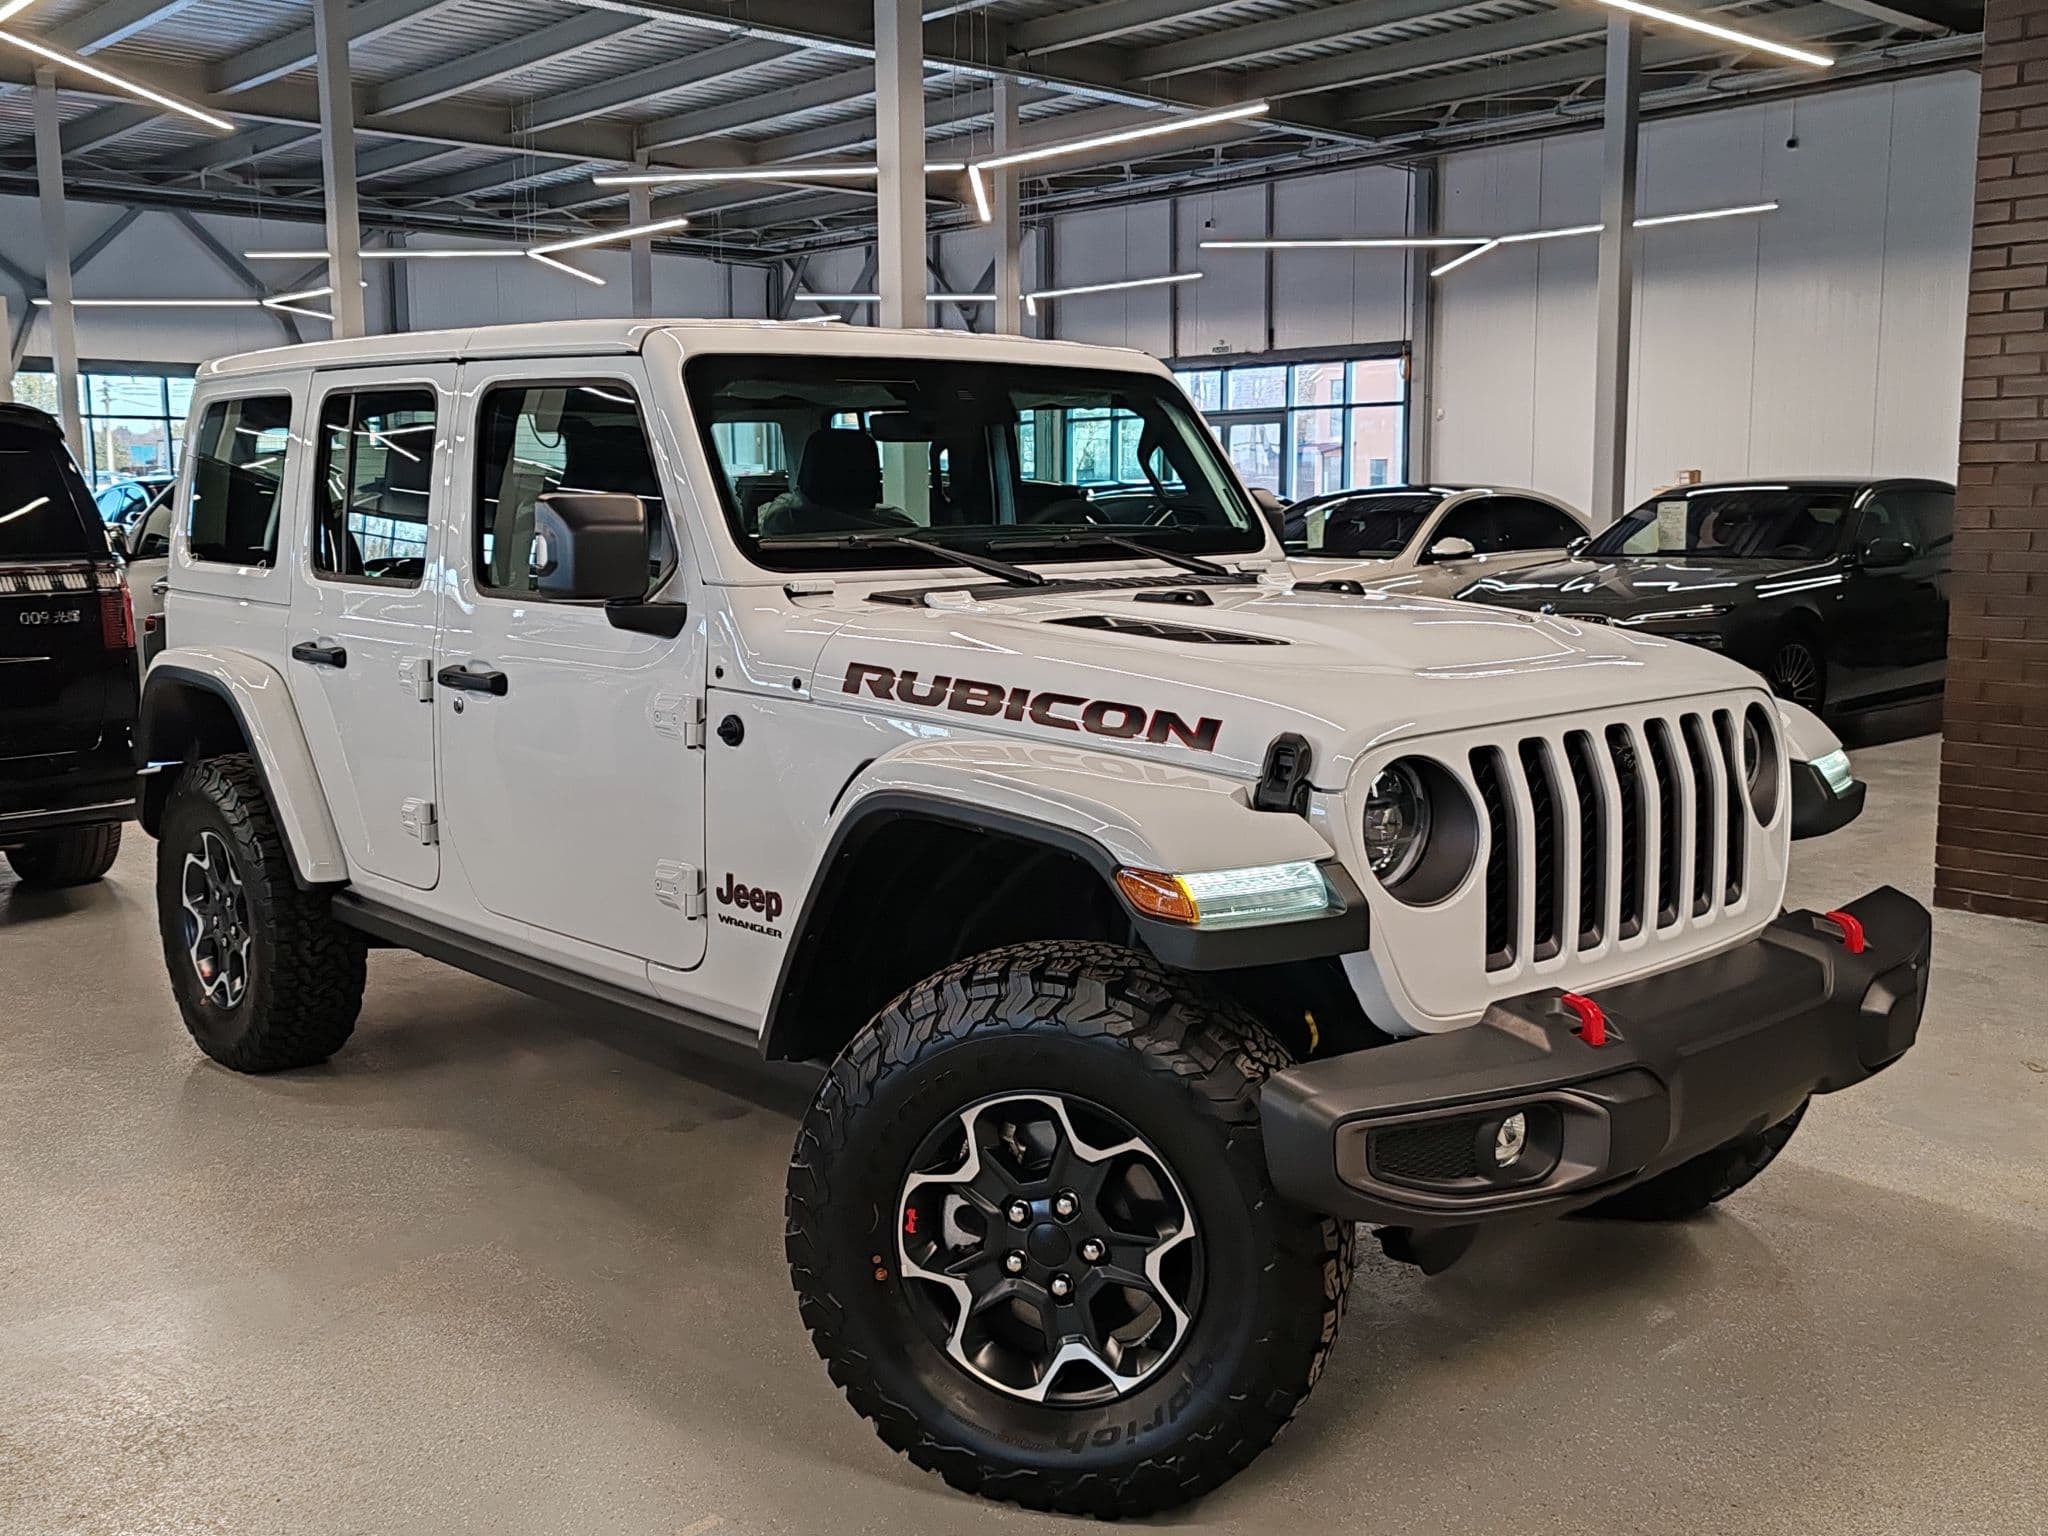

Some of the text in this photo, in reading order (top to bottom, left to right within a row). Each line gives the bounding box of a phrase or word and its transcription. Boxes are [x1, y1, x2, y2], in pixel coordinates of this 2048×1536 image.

[841, 661, 1224, 752] RUBICON
[715, 871, 783, 922] Jeep
[717, 912, 783, 940] WRANGLER
